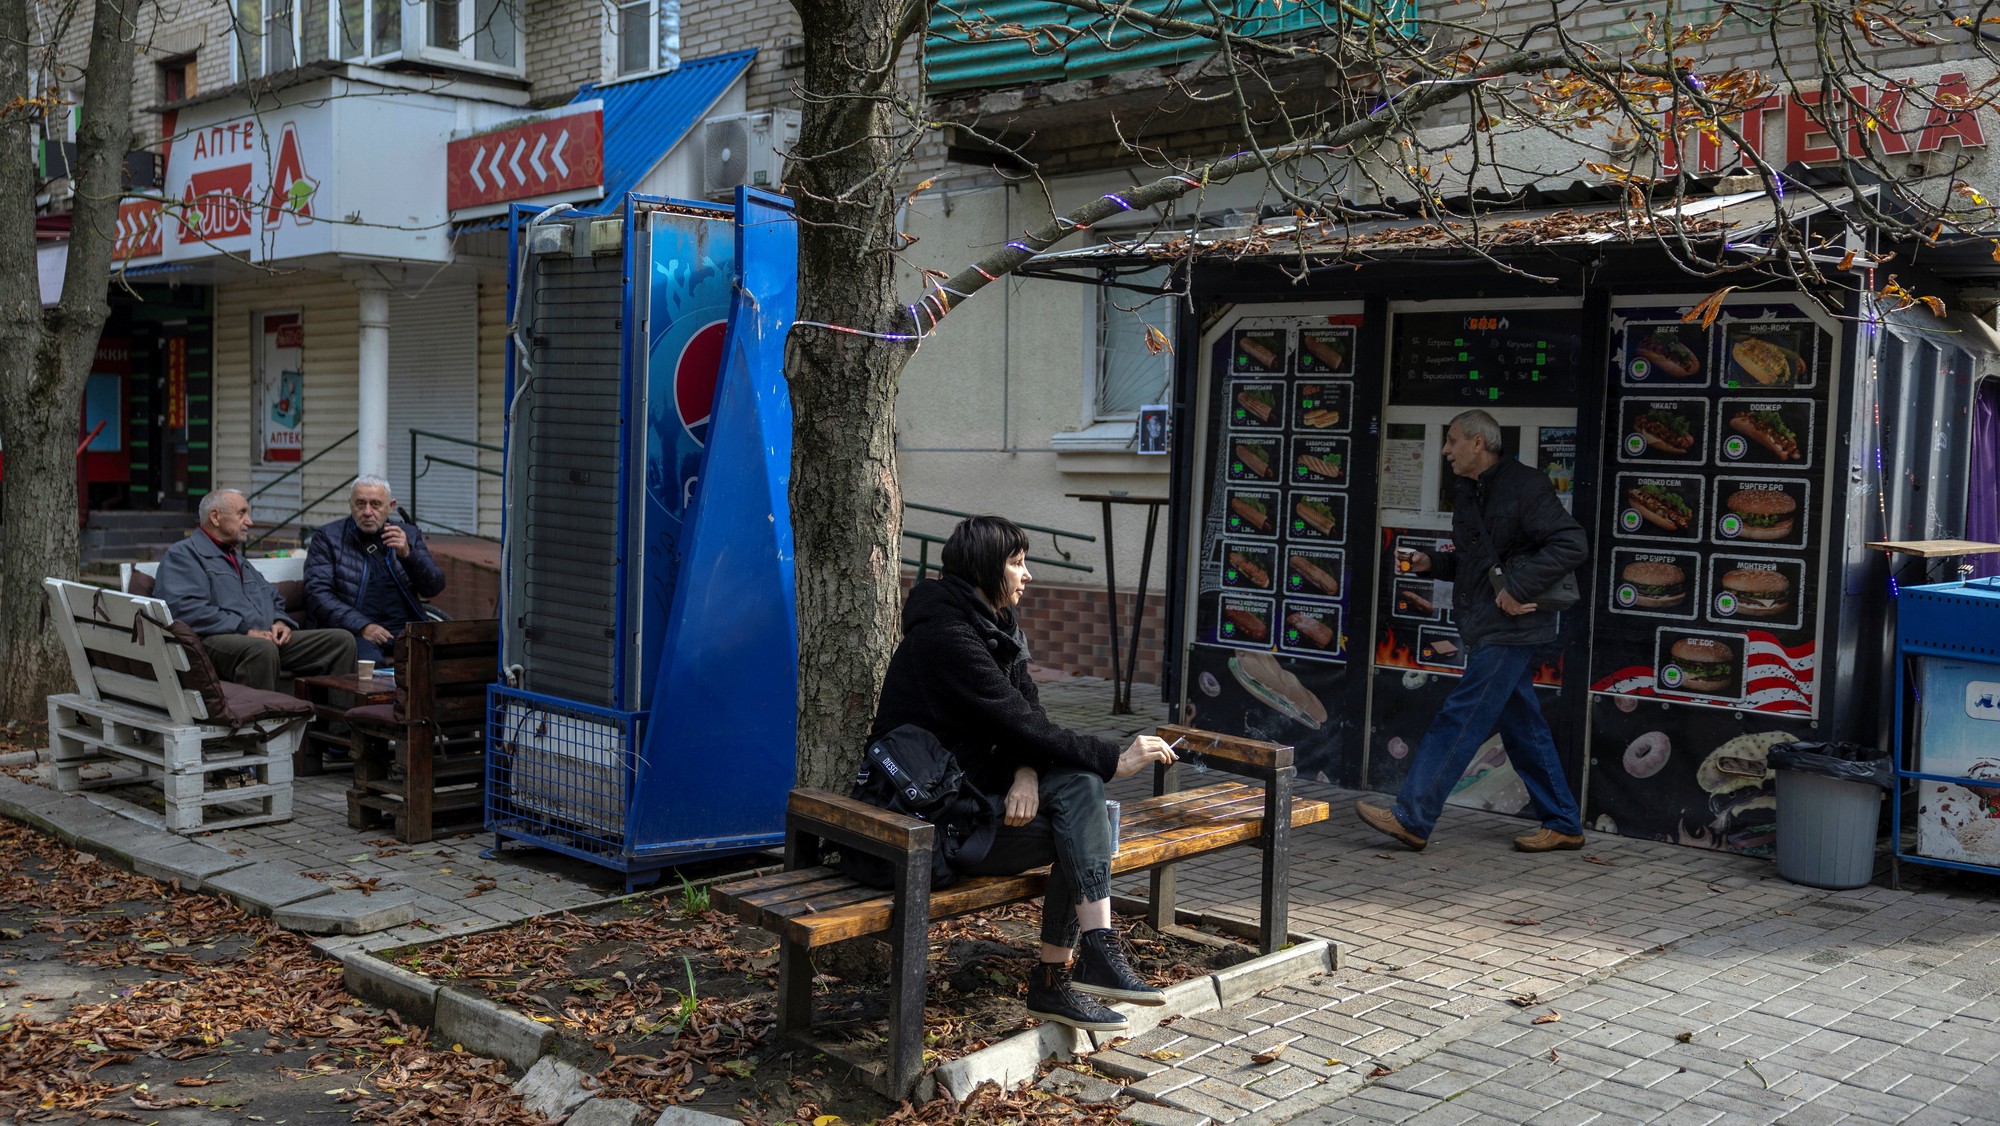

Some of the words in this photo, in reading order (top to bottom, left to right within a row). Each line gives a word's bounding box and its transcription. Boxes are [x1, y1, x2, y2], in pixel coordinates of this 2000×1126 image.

[1657, 325, 1680, 333] ВЕГАС
[1750, 324, 1790, 332] НЬЮ-ЙОРК
[1650, 402, 1678, 410] ЧИКАГО
[1667, 479, 1681, 487] СЕМ
[1739, 483, 1766, 491] БУРГЕР
[1650, 555, 1676, 563] БУРГЕР
[1737, 561, 1777, 571] МОНТЕРЕЙ
[1699, 639, 1714, 647] БОС
[882, 757, 899, 776] DIESEL
